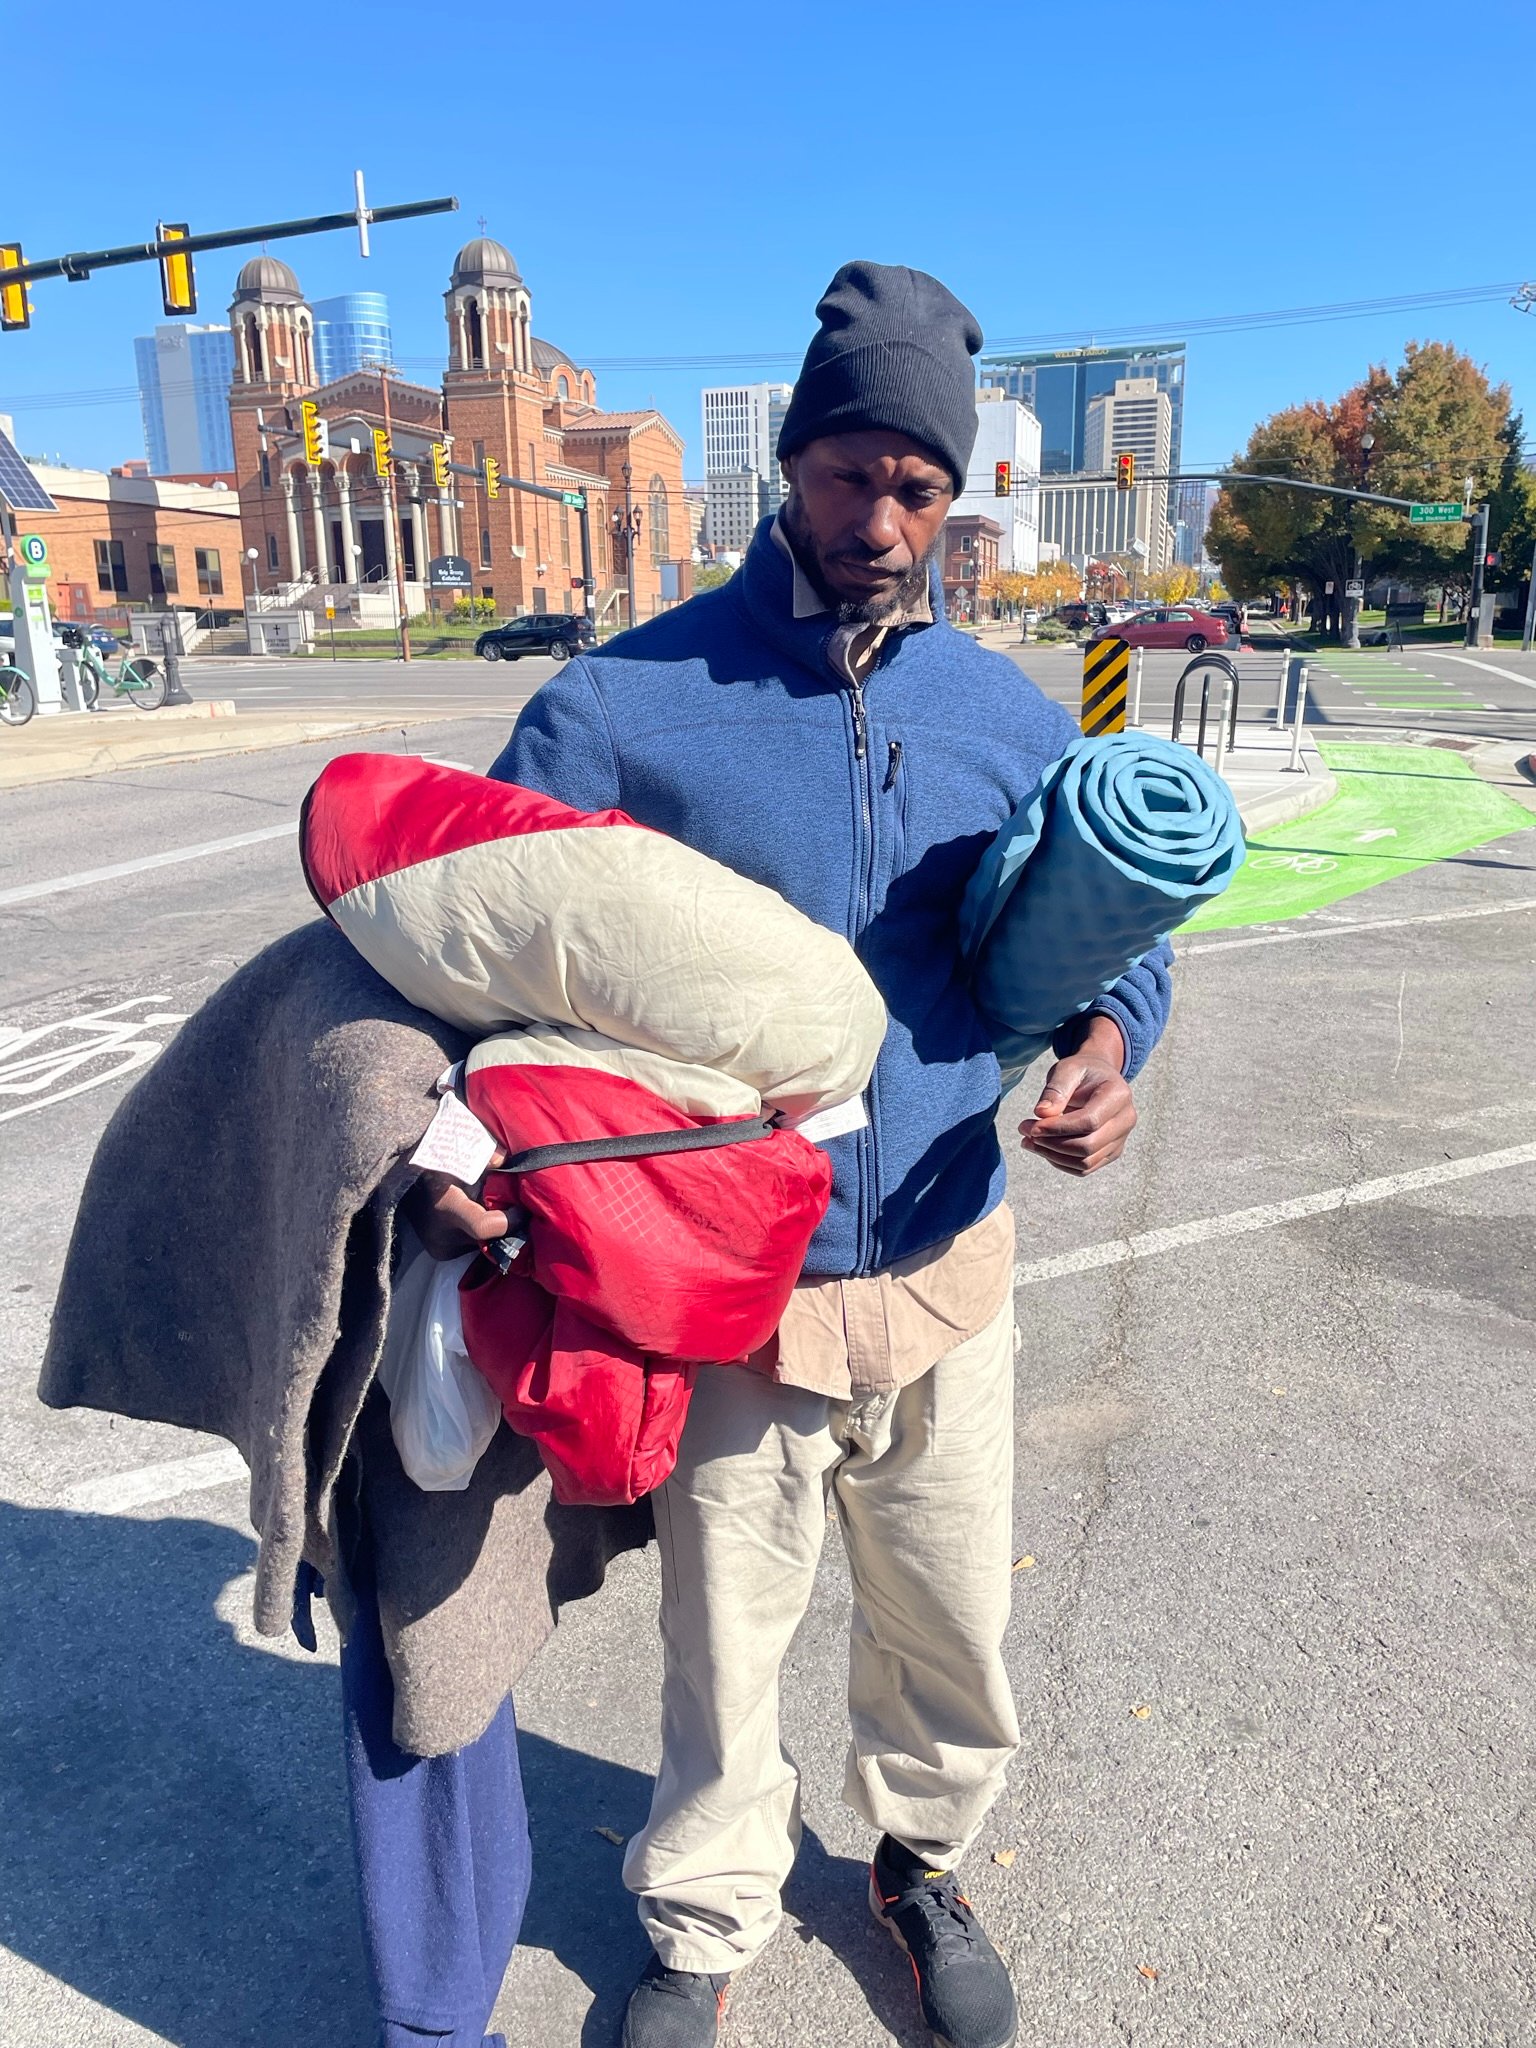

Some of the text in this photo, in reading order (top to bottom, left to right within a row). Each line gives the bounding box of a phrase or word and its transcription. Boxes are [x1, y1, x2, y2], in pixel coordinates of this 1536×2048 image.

[1419, 506, 1455, 515] 300 West
[30, 541, 43, 559] B
